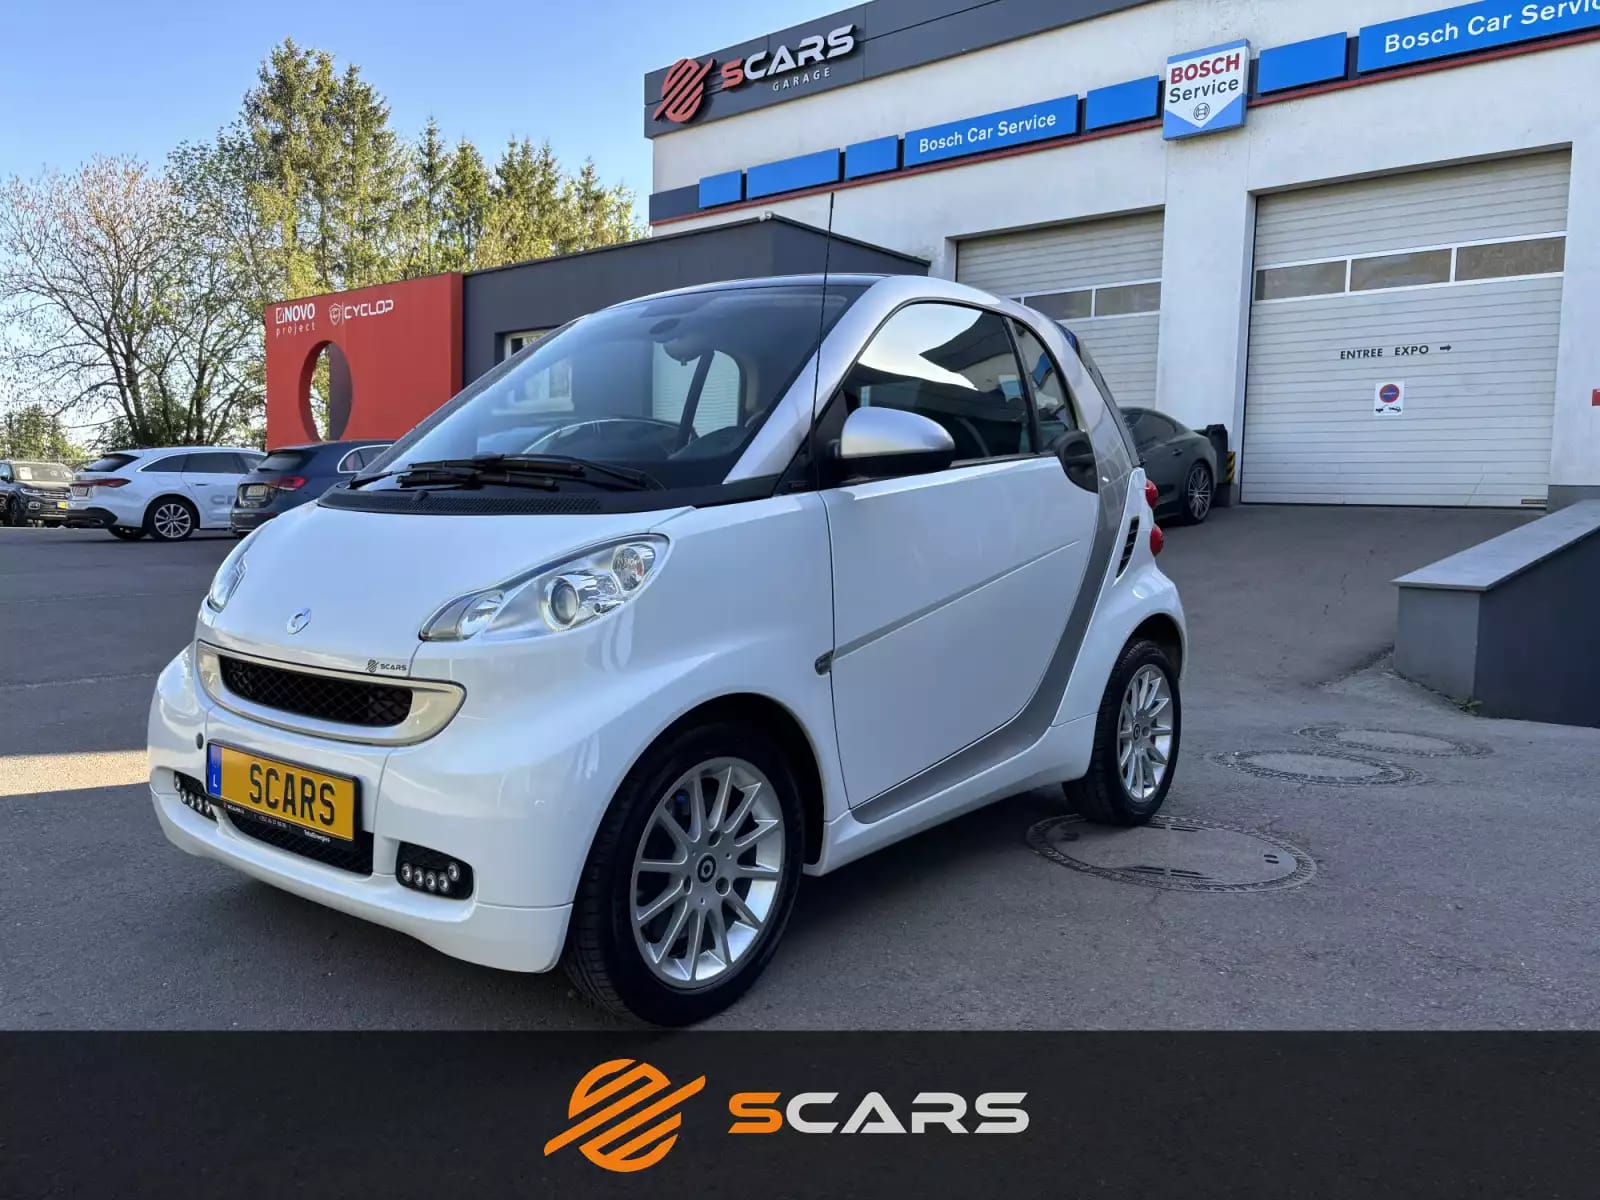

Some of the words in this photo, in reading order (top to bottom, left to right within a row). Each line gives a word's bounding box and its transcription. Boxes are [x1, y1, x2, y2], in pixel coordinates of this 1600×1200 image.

[1385, 22, 1459, 53] Bosch
[1467, 14, 1512, 36] Car
[721, 24, 855, 89] SCARS
[1170, 53, 1240, 84] BOSCH
[773, 67, 831, 91] GARAGE
[1169, 79, 1239, 104] Service
[919, 131, 963, 153] Bosch
[967, 127, 994, 142] Car
[997, 113, 1057, 137] Service
[344, 299, 394, 319] CYCLOP
[276, 322, 316, 337] project
[1340, 348, 1383, 360] ENTREE
[1394, 345, 1429, 356] EXPO
[380, 663, 407, 671] SCARS
[249, 763, 336, 826] SCARS
